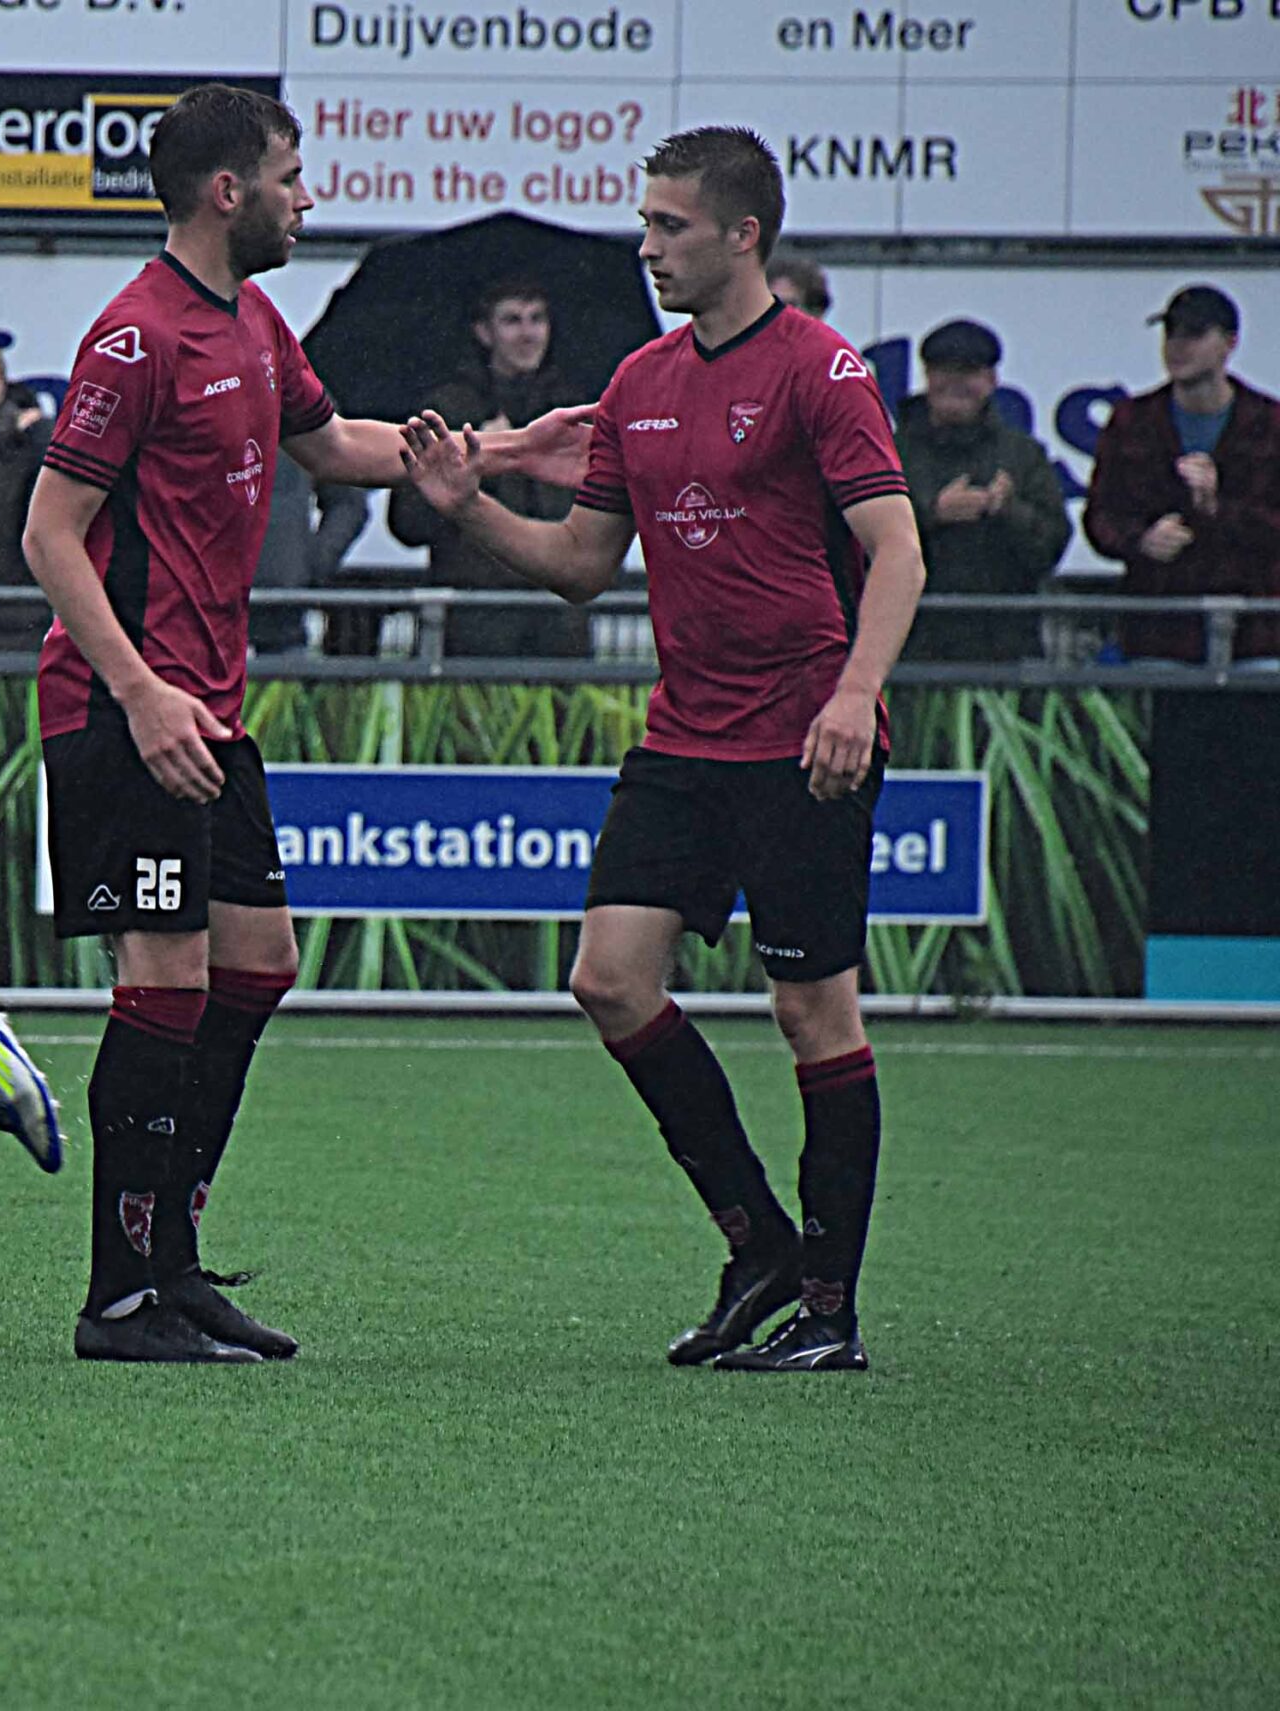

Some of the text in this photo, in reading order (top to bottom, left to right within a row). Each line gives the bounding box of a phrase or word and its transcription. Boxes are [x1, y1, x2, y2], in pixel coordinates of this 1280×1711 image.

[312, 5, 654, 59] Duijvenbode
[777, 8, 975, 51] en Meer
[314, 98, 644, 152] Hier uw logo?
[315, 162, 639, 205] Join the club!
[787, 134, 957, 180] KNMR
[272, 810, 948, 874] ankstation eel
[135, 857, 182, 911] 26
